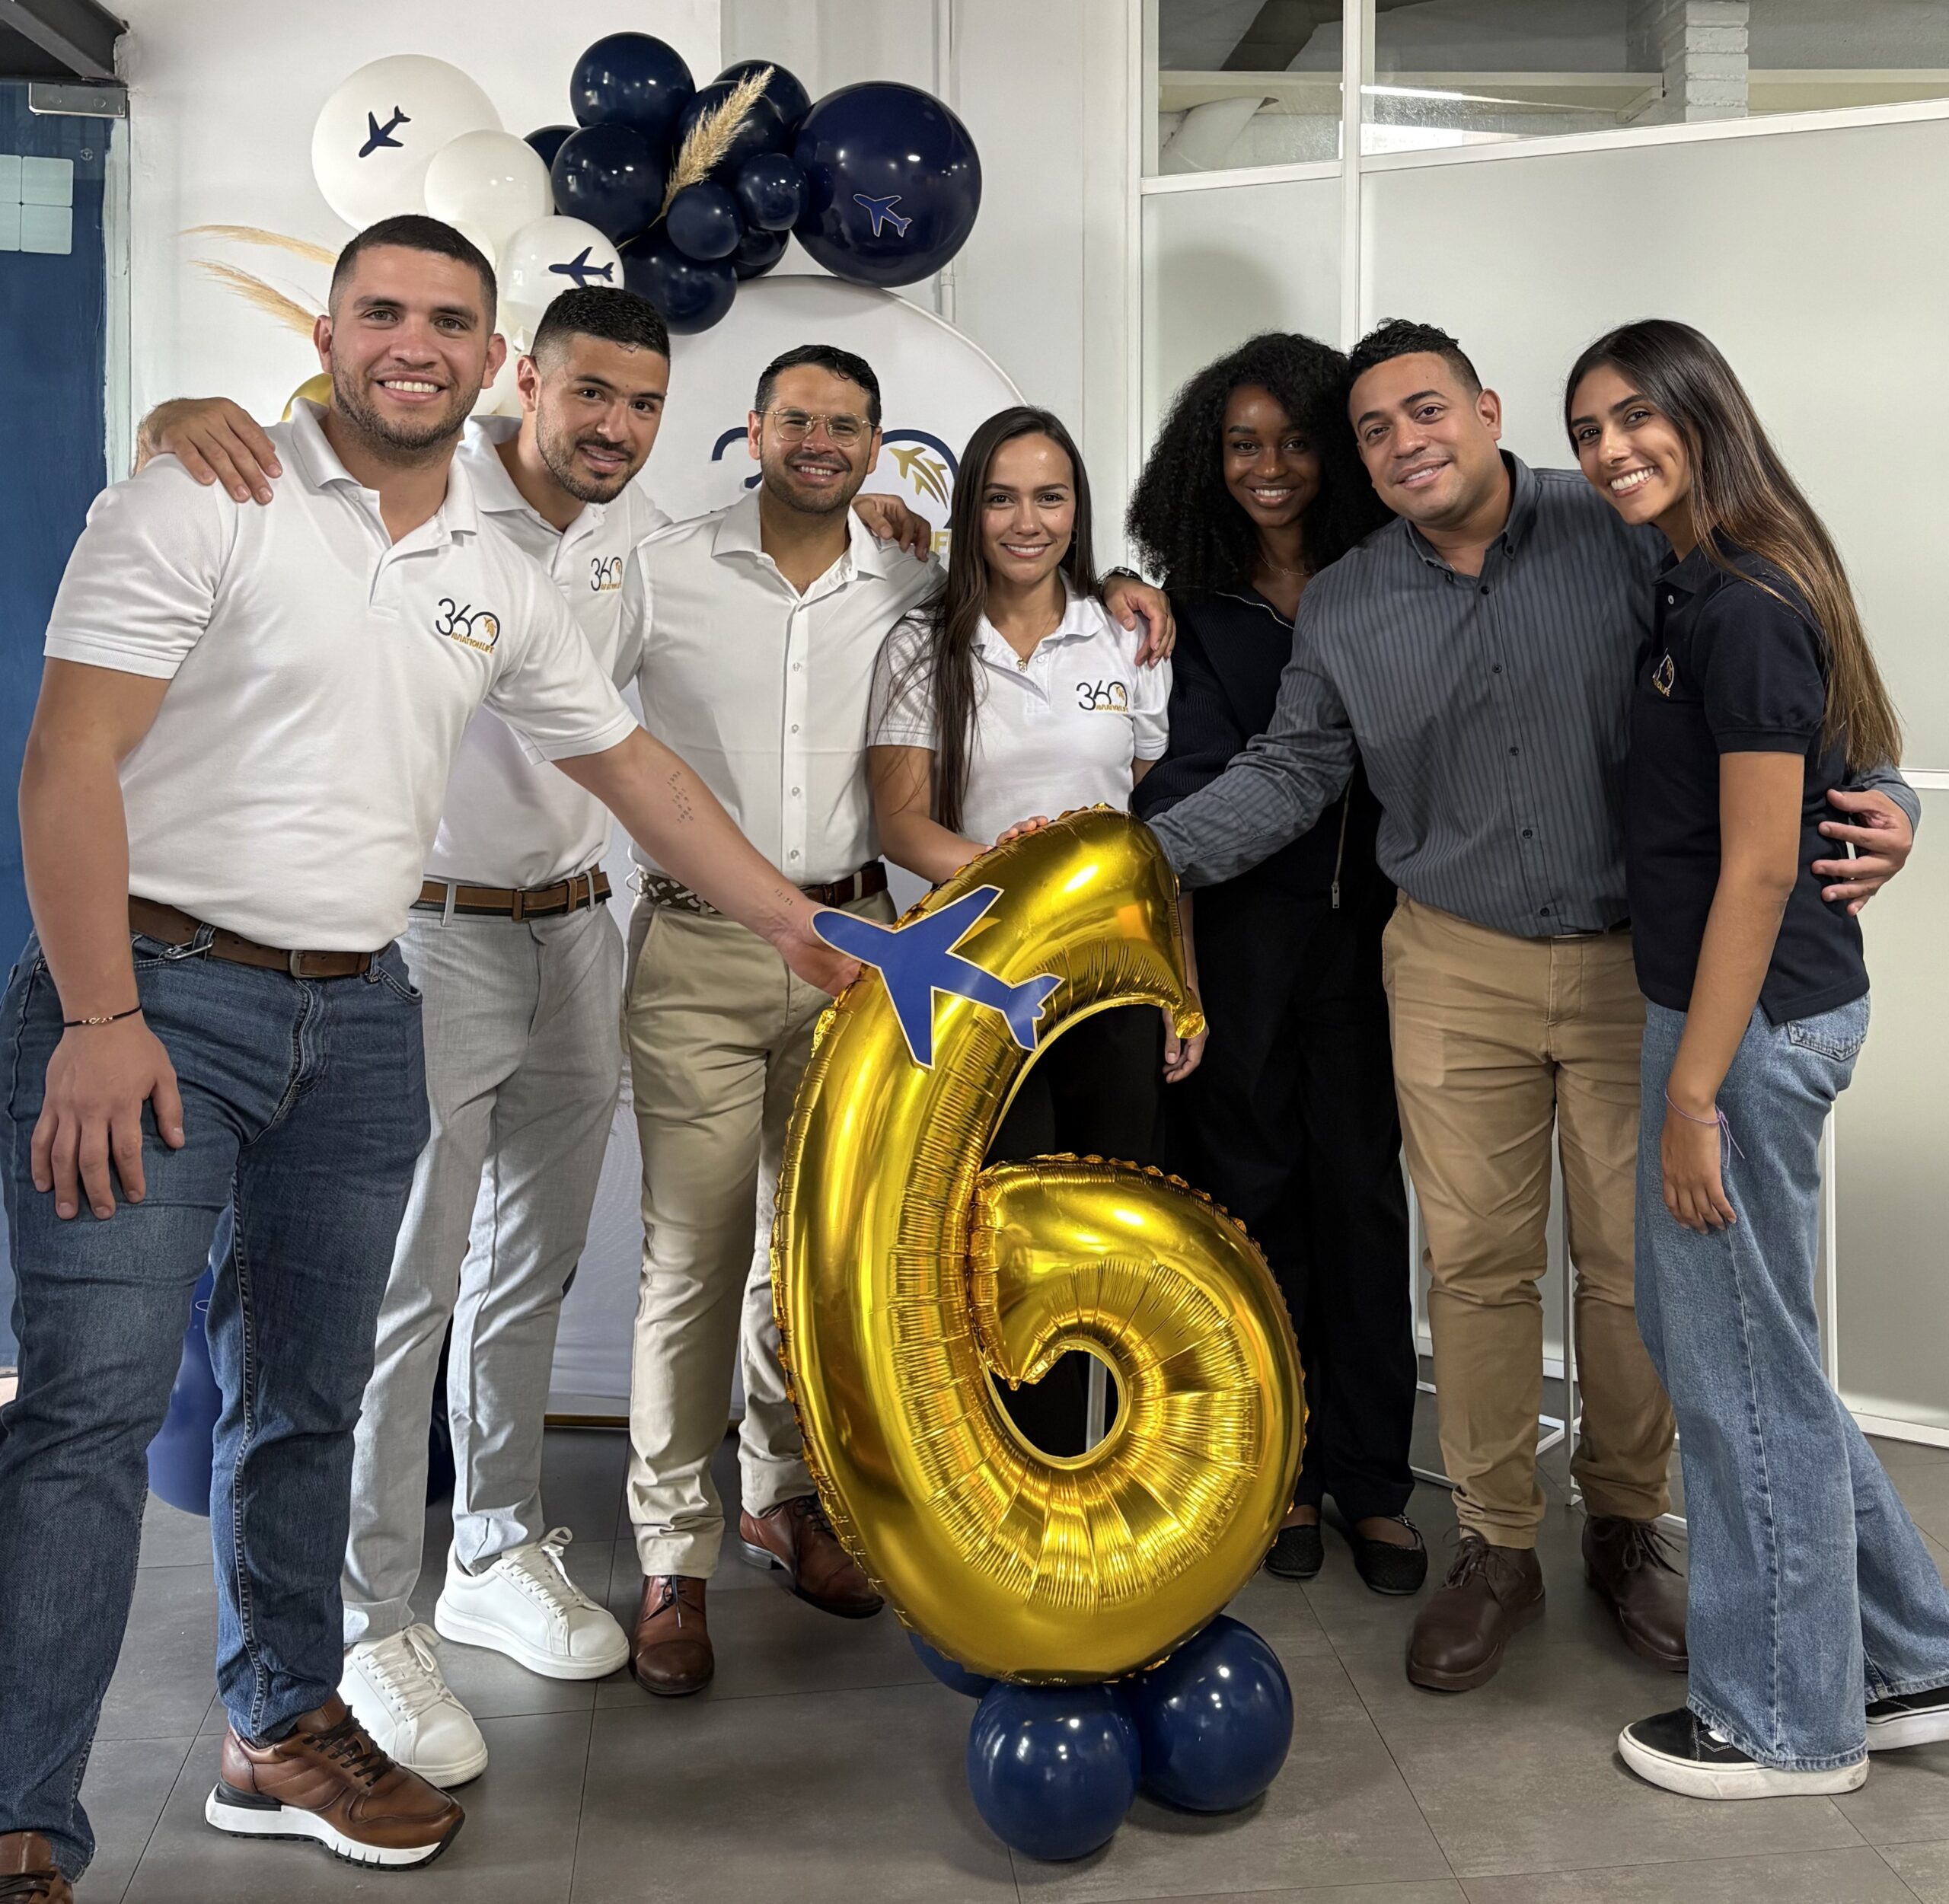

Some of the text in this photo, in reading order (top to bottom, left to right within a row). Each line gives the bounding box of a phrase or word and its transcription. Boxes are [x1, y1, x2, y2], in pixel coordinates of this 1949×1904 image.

[591, 556, 624, 592] 360
[435, 598, 501, 647] 360
[1076, 679, 1128, 711] 360
